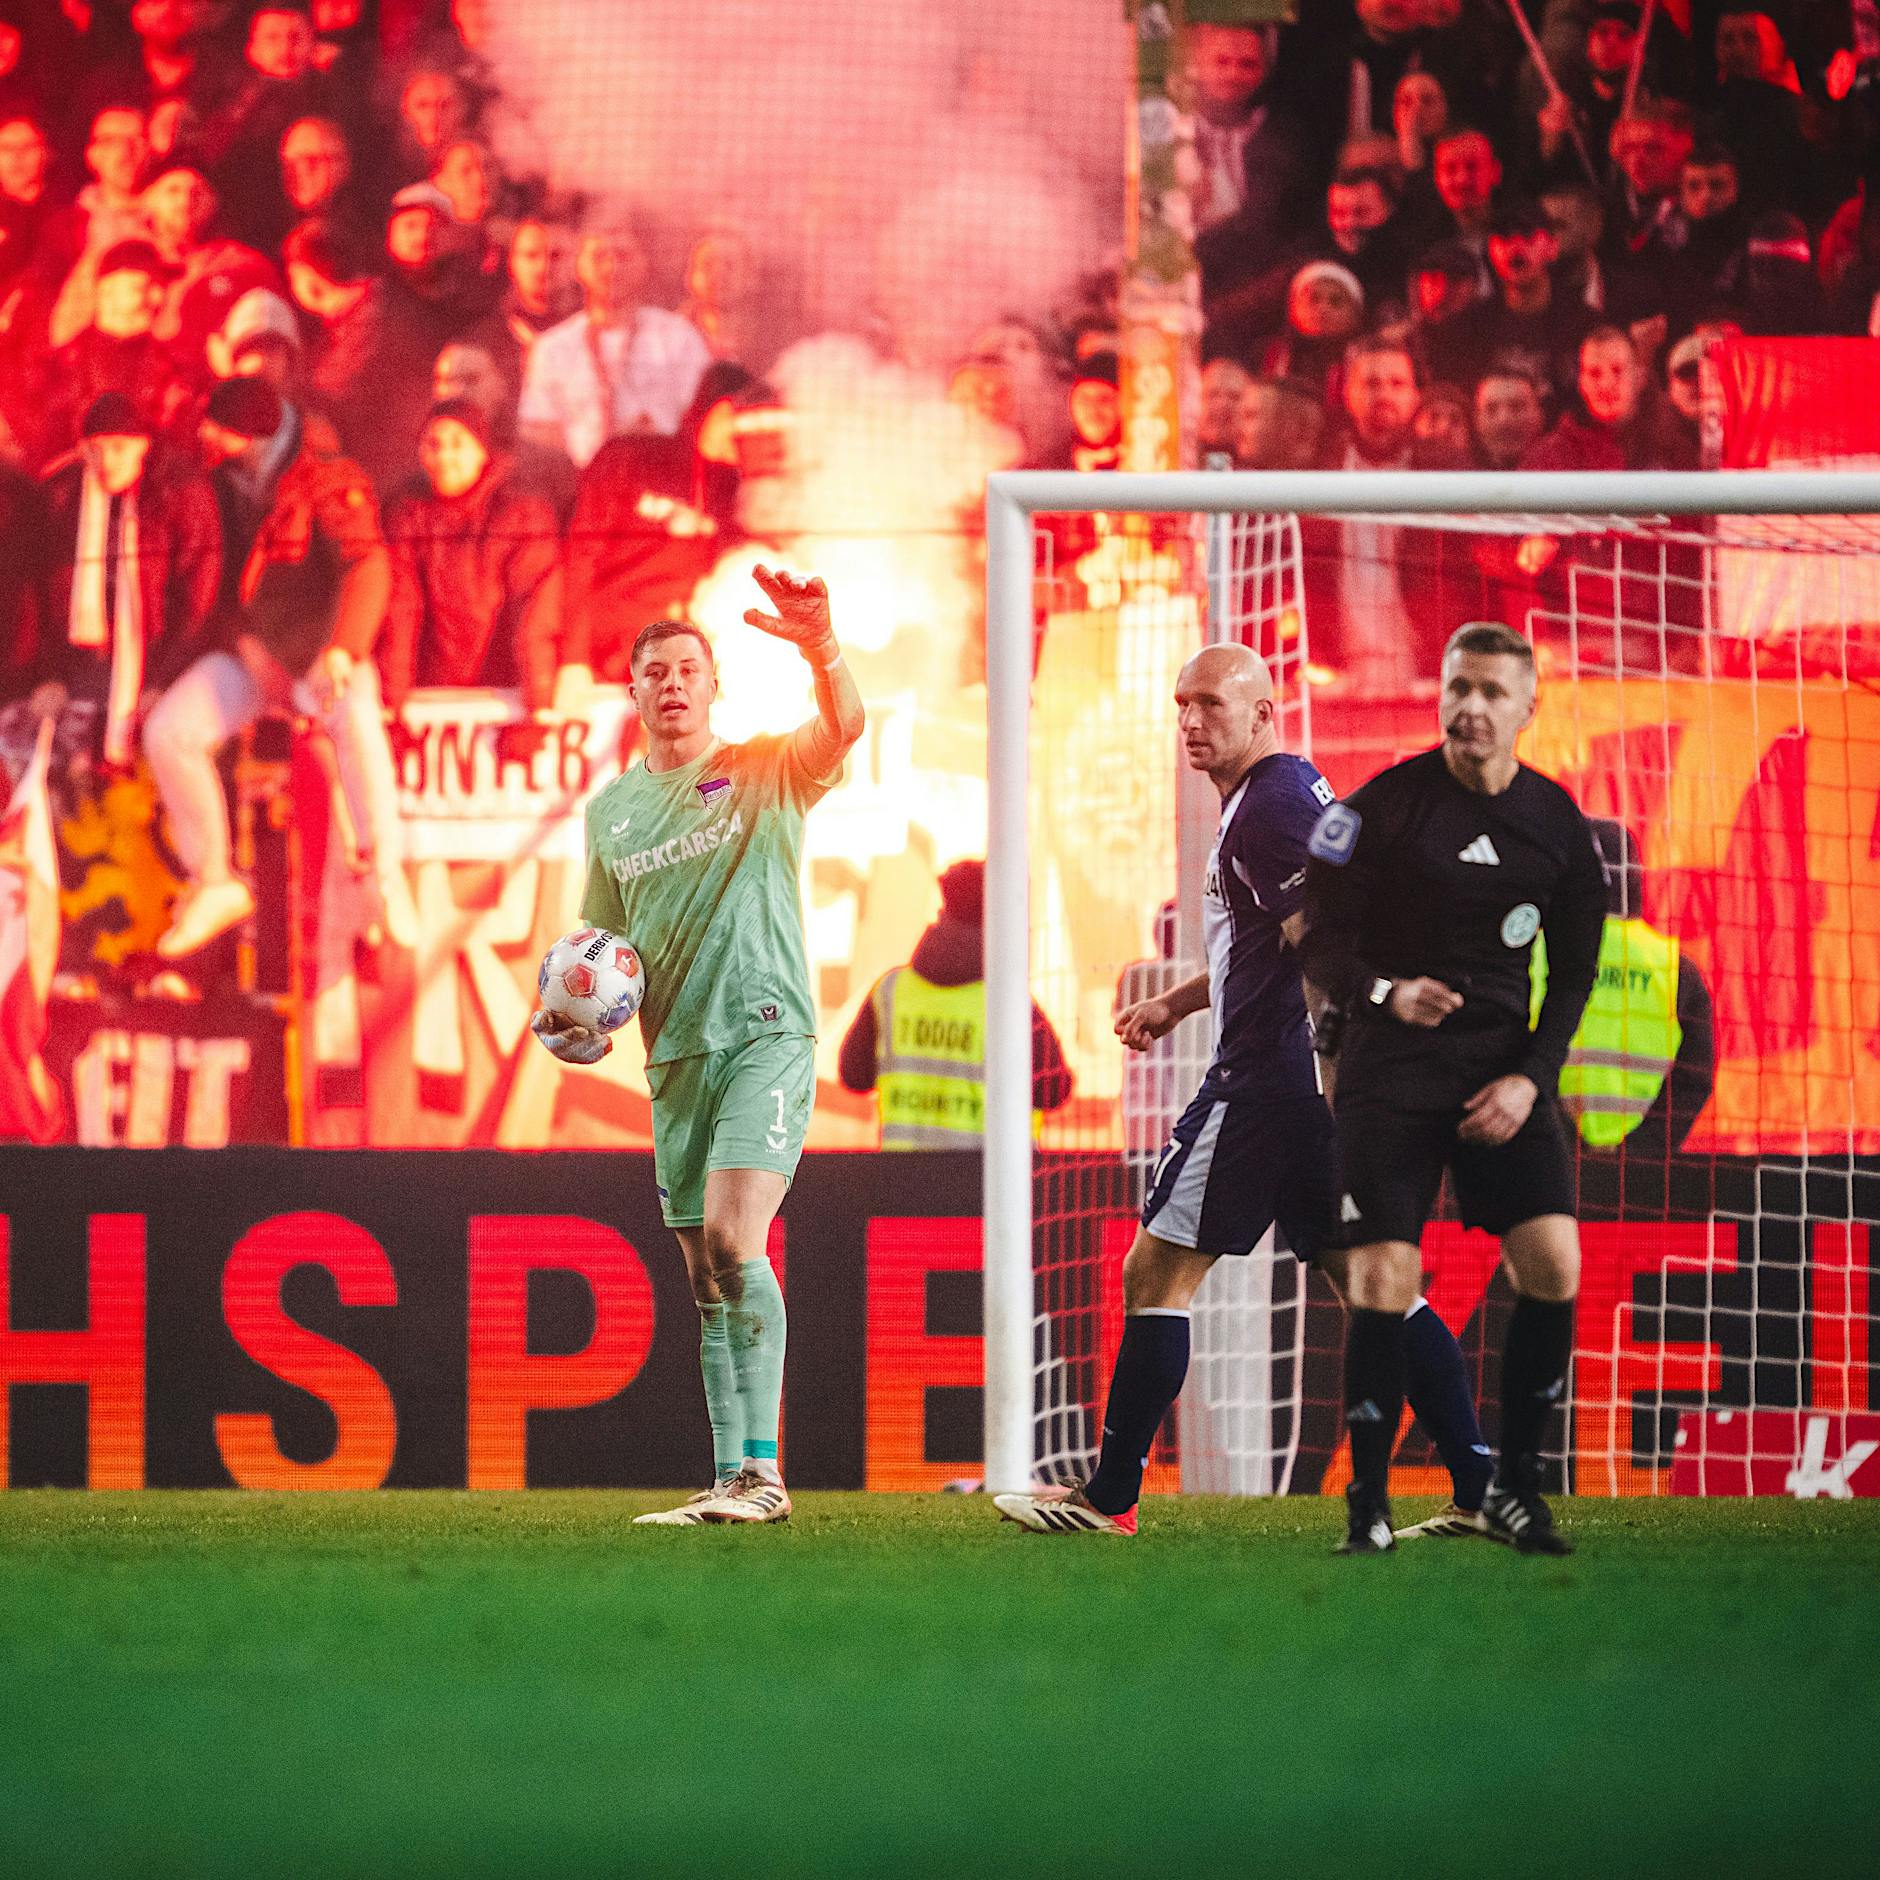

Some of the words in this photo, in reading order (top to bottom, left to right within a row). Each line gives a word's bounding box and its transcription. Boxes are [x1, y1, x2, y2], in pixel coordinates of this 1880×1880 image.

[612, 810, 743, 883] CHECKCARS24
[769, 1088, 788, 1134] 1
[1152, 1137, 1183, 1189] 7
[0, 1210, 1870, 1496] HSPEZEI
